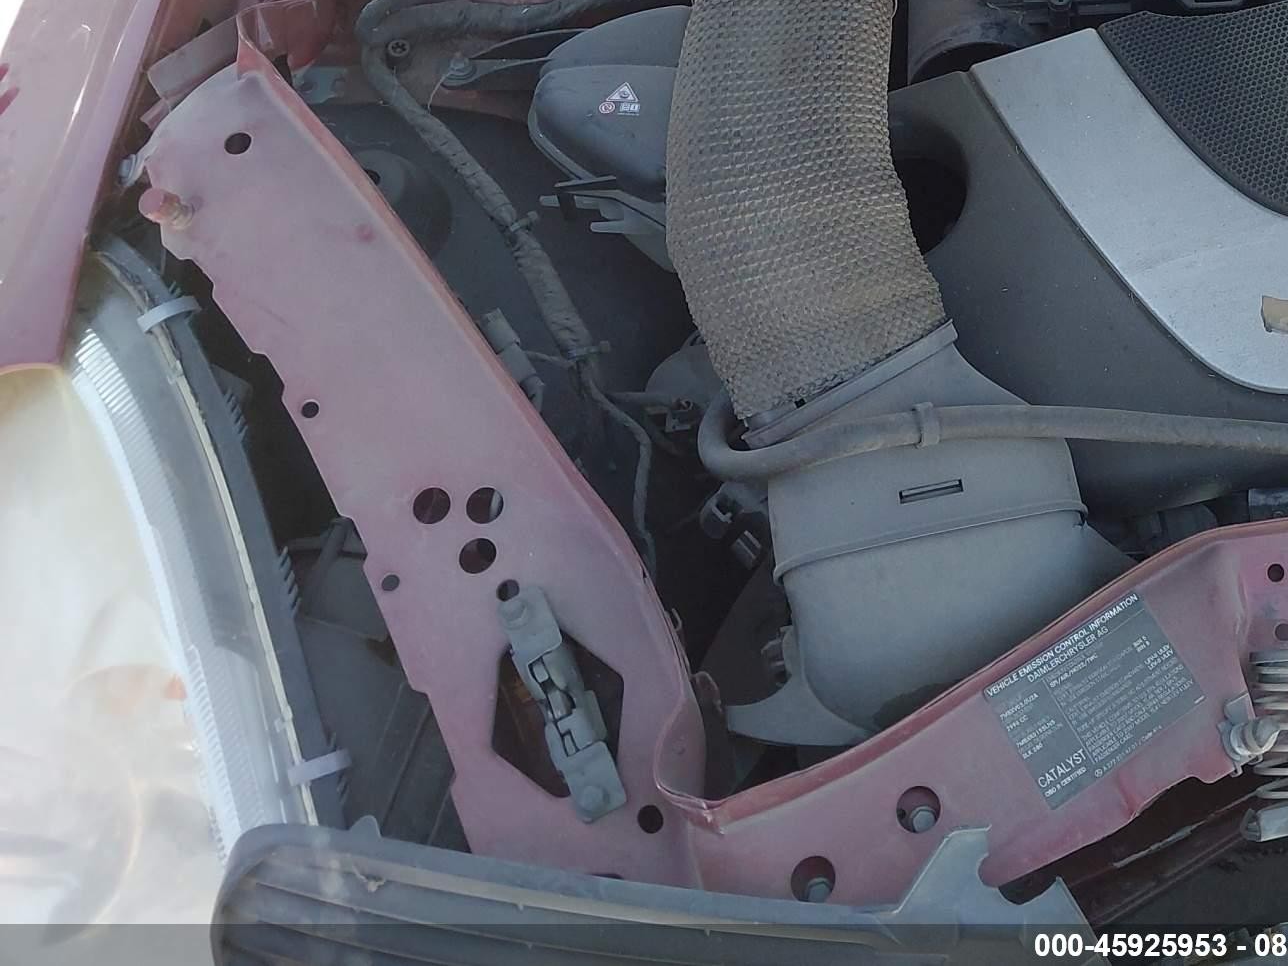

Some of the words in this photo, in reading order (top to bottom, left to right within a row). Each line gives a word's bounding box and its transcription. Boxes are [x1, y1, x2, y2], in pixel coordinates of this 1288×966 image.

[988, 673, 1019, 696] VEHICLE
[1019, 651, 1055, 676] EMISSION
[1055, 628, 1090, 653] CONTROL
[1089, 594, 1138, 631] INFORMATION
[1028, 634, 1096, 681] DAIMLERCHRYSLER
[1096, 625, 1109, 637] AG
[1038, 749, 1087, 788] CATALYST
